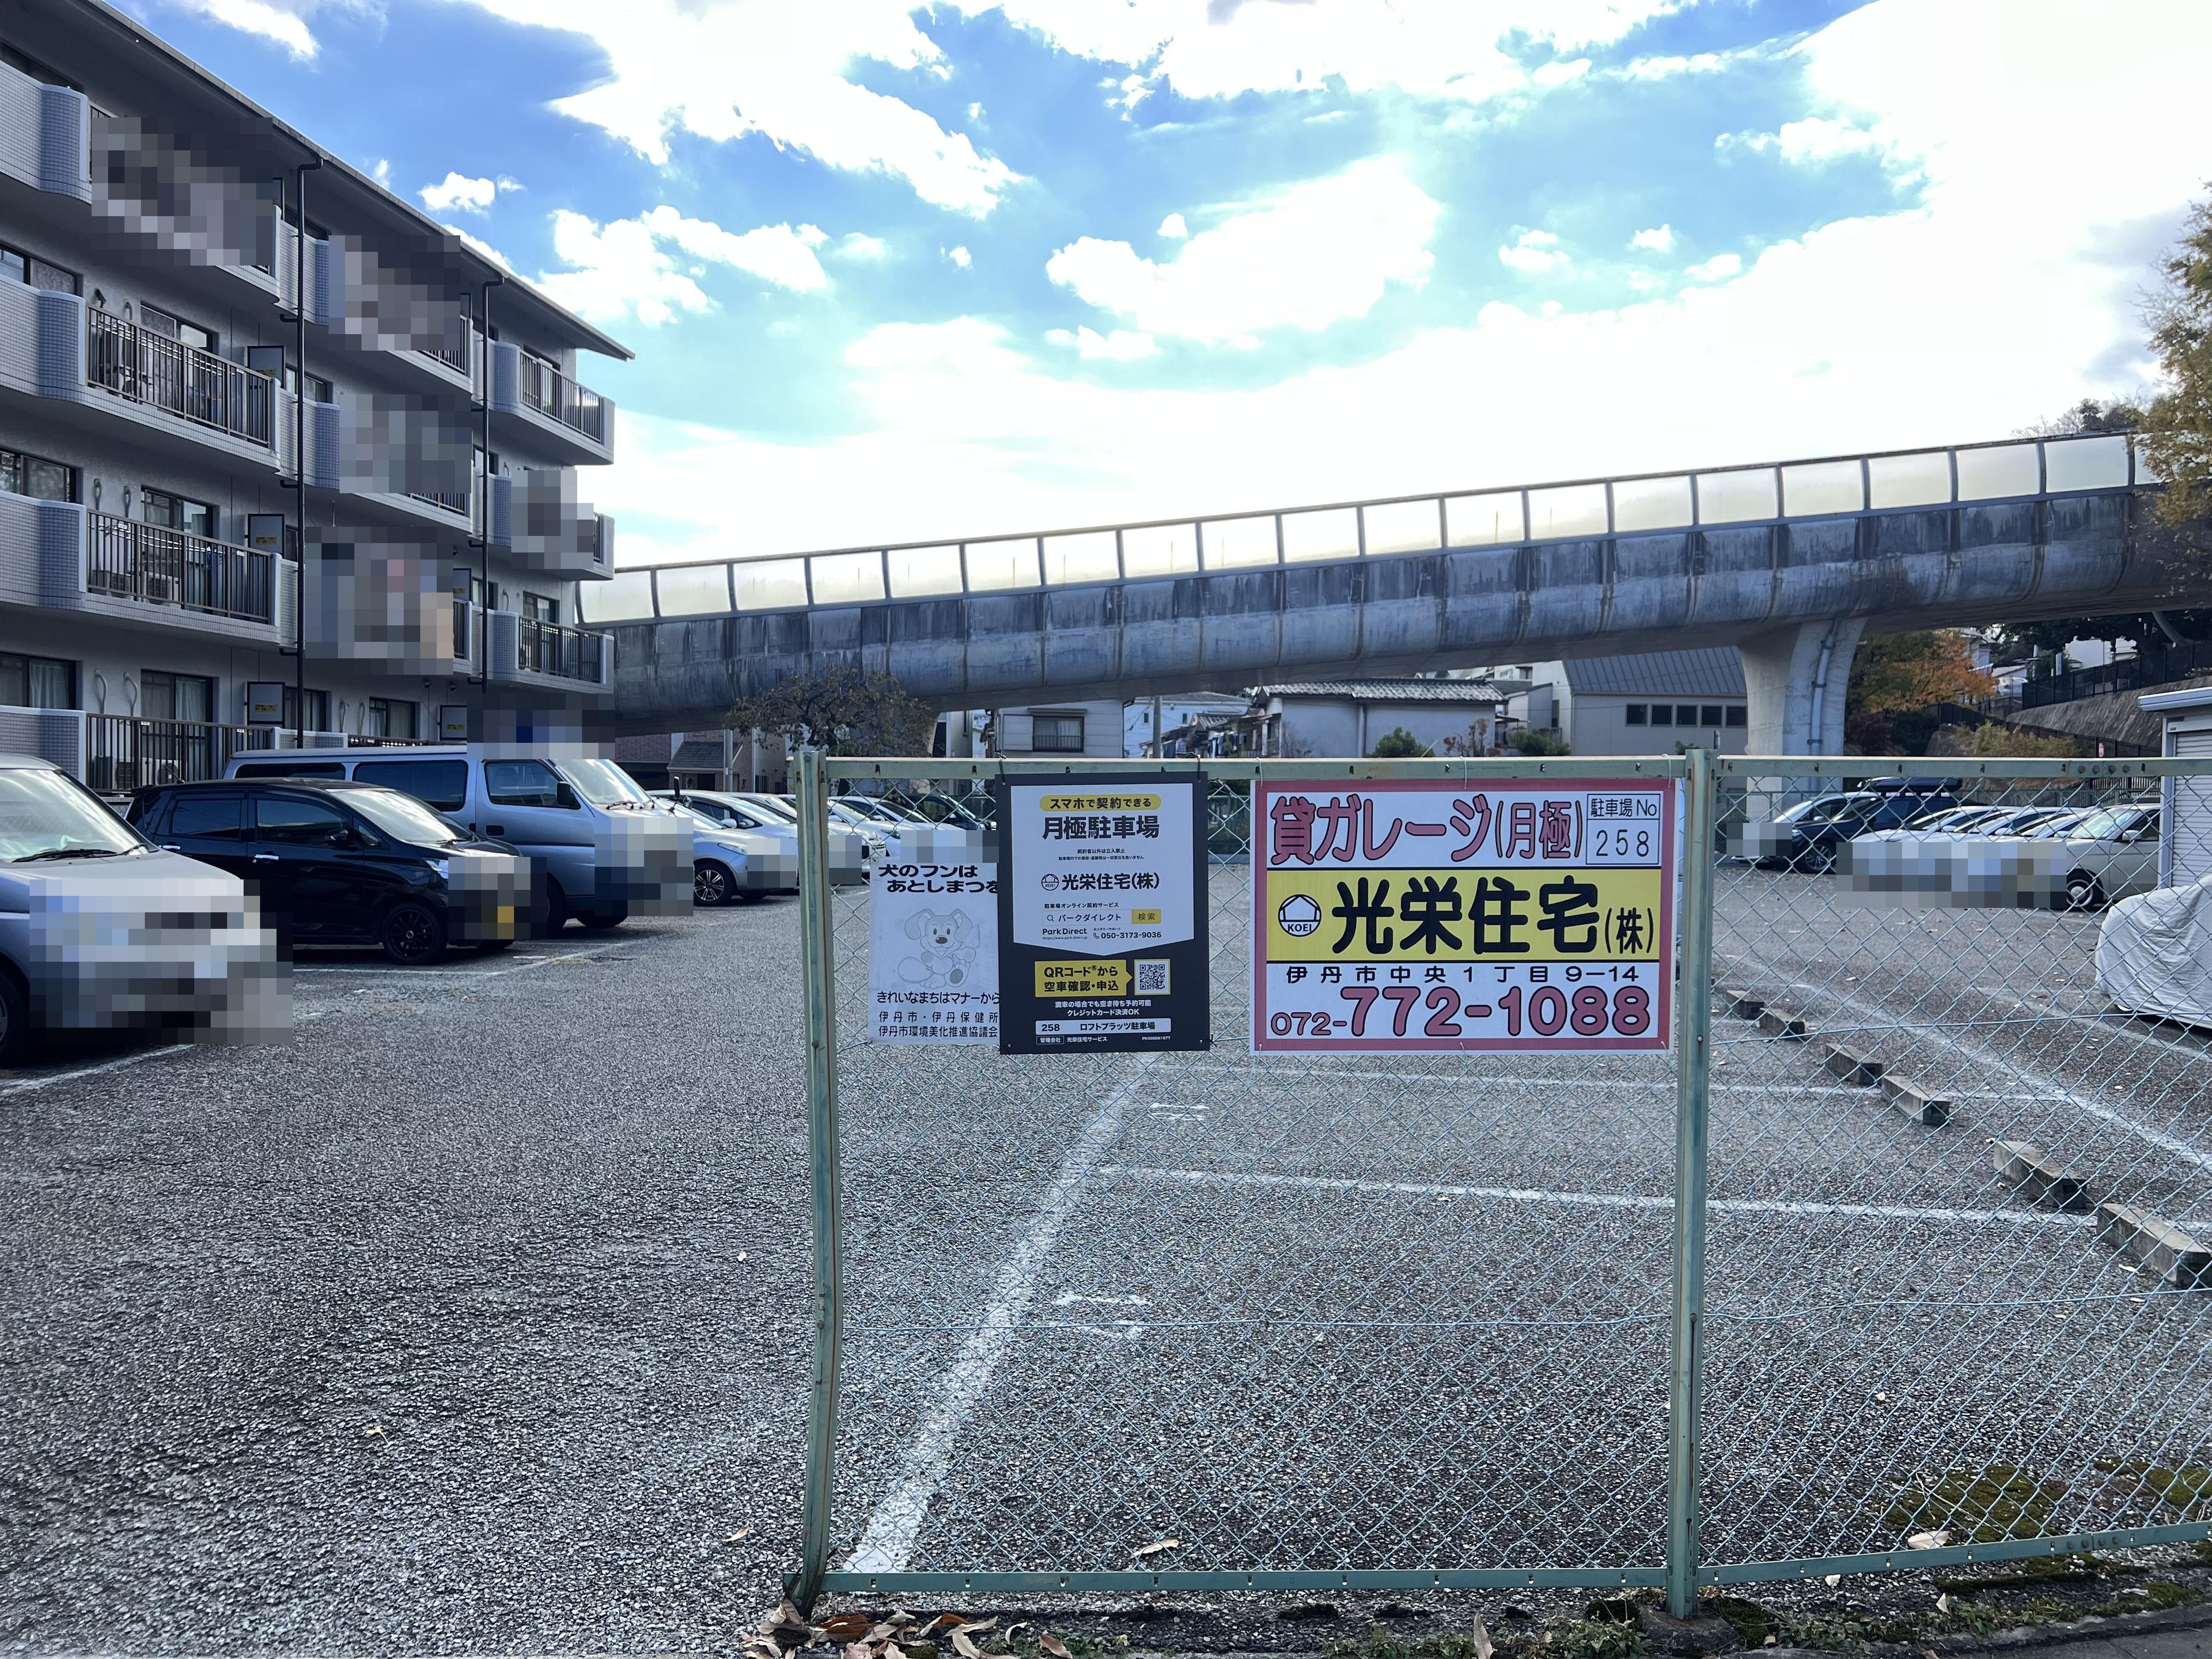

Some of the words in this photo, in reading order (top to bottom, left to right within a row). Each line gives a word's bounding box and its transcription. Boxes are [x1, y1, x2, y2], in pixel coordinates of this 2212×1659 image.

[1050, 797, 1151, 810] スマホで契約できる
[1042, 815, 1160, 840] 月極駐車場
[1271, 794, 1584, 865] 貸ガレージ(月極)
[1596, 829, 1649, 857] 258
[878, 864, 978, 878] 犬のフンは
[1062, 872, 1160, 891] 光栄住宅(株)
[1058, 914, 1121, 922] パークダイレクト
[1138, 912, 1156, 921] 検索
[1332, 874, 1654, 955] 光栄住宅(株)
[1287, 923, 1313, 933] KOEI
[1044, 980, 1119, 992] 空車確認・申込
[877, 991, 1000, 1005] きれいなまちはマナーから
[1055, 999, 1152, 1008] 満車の場合でも空き待ち予約可能
[879, 1011, 999, 1023] 伊丹市・伊丹保健所
[1271, 985, 1650, 1037] 072-772-1088
[878, 1025, 998, 1037] 伊丹市環境美化推進協議会
[1041, 1024, 1060, 1032] 258
